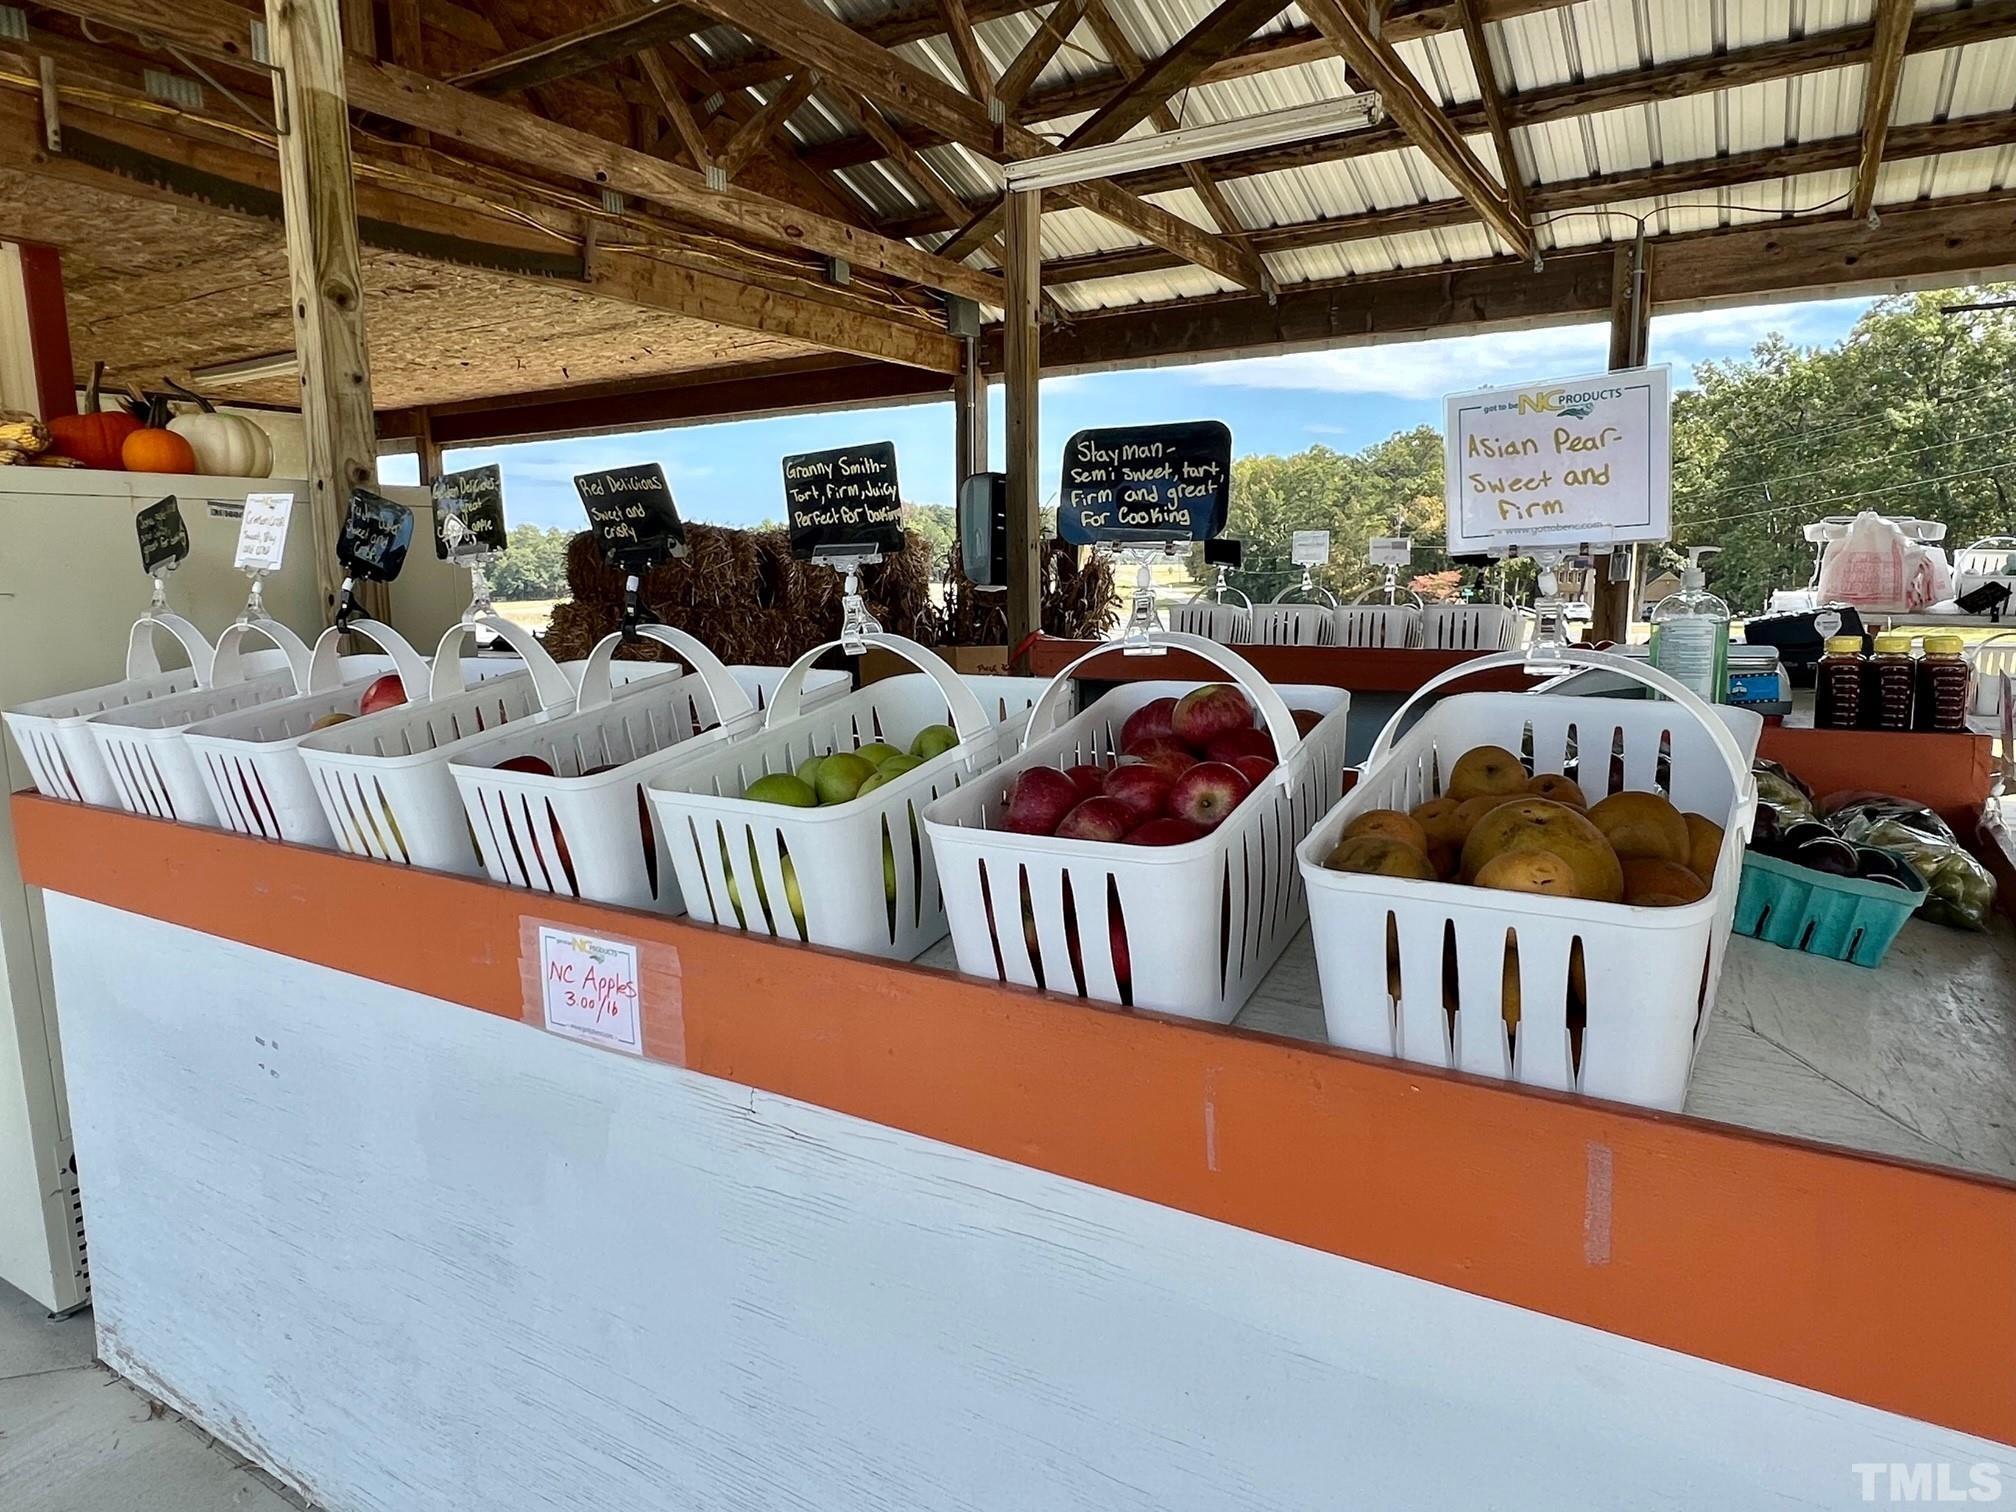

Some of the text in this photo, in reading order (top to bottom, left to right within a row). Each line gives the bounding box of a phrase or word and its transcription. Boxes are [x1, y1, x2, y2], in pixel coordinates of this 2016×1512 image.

[1498, 403, 1507, 411] to
[1518, 389, 1566, 415] NC
[1558, 387, 1622, 405] PRODUCTS
[1468, 433, 1539, 458] Asian
[786, 462, 833, 479] Granny
[1468, 463, 1610, 494] Sweet and
[579, 478, 604, 496] Red
[1124, 485, 1158, 502] and
[1167, 480, 1218, 510] great
[625, 502, 645, 518] and
[1497, 498, 1564, 520] Firm
[550, 961, 637, 1000] NC Apples
